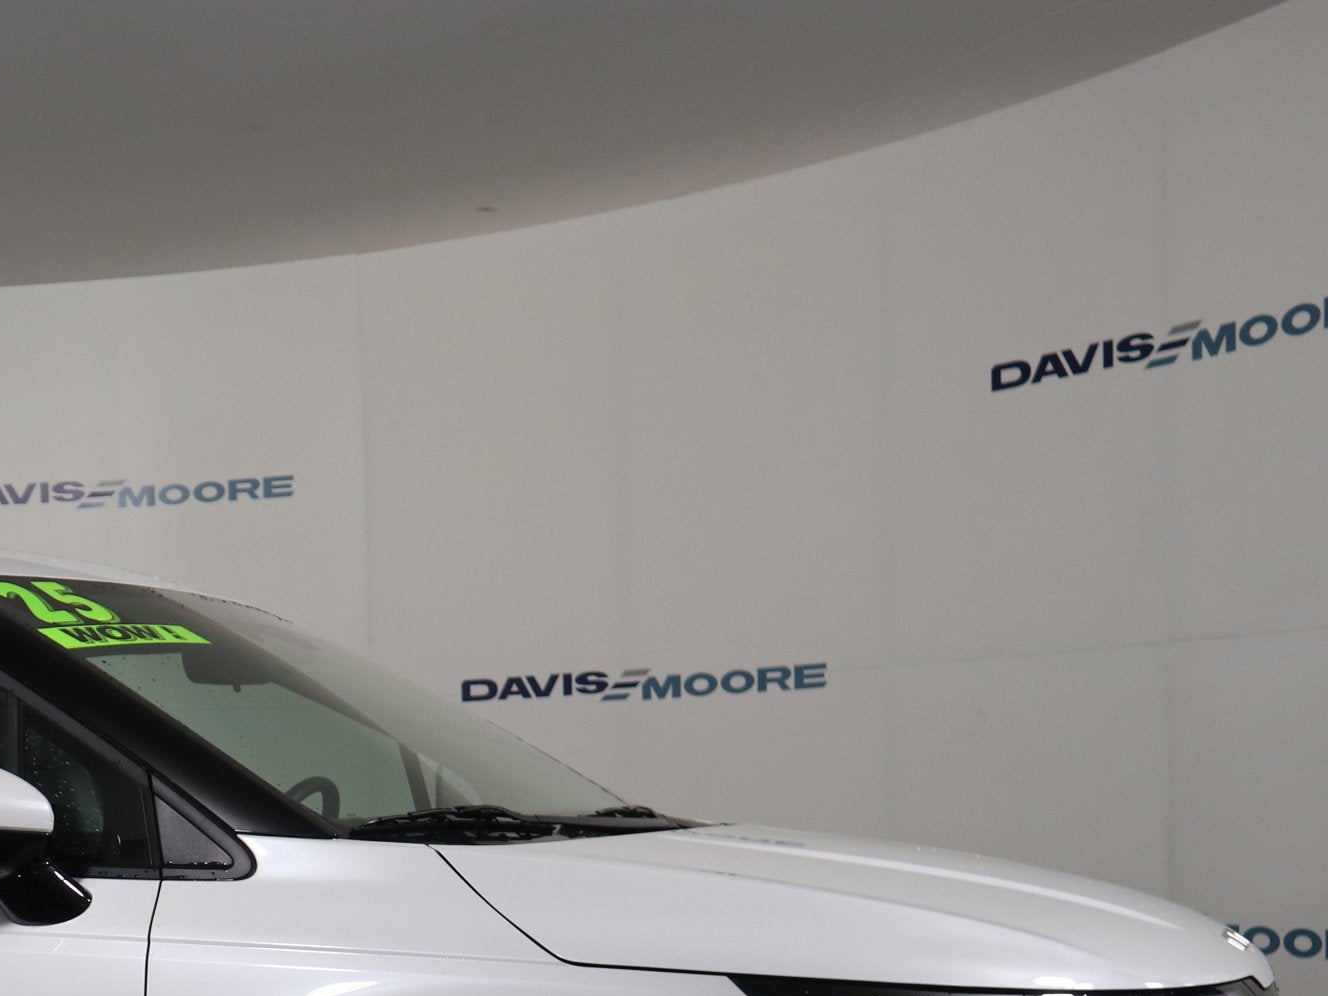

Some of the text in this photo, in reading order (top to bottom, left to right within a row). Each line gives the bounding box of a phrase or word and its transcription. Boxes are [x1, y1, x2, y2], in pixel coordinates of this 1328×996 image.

[991, 297, 1328, 392] DAVIS MOO
[116, 474, 294, 508] MOORE
[461, 662, 827, 702] DAVIS MOORE
